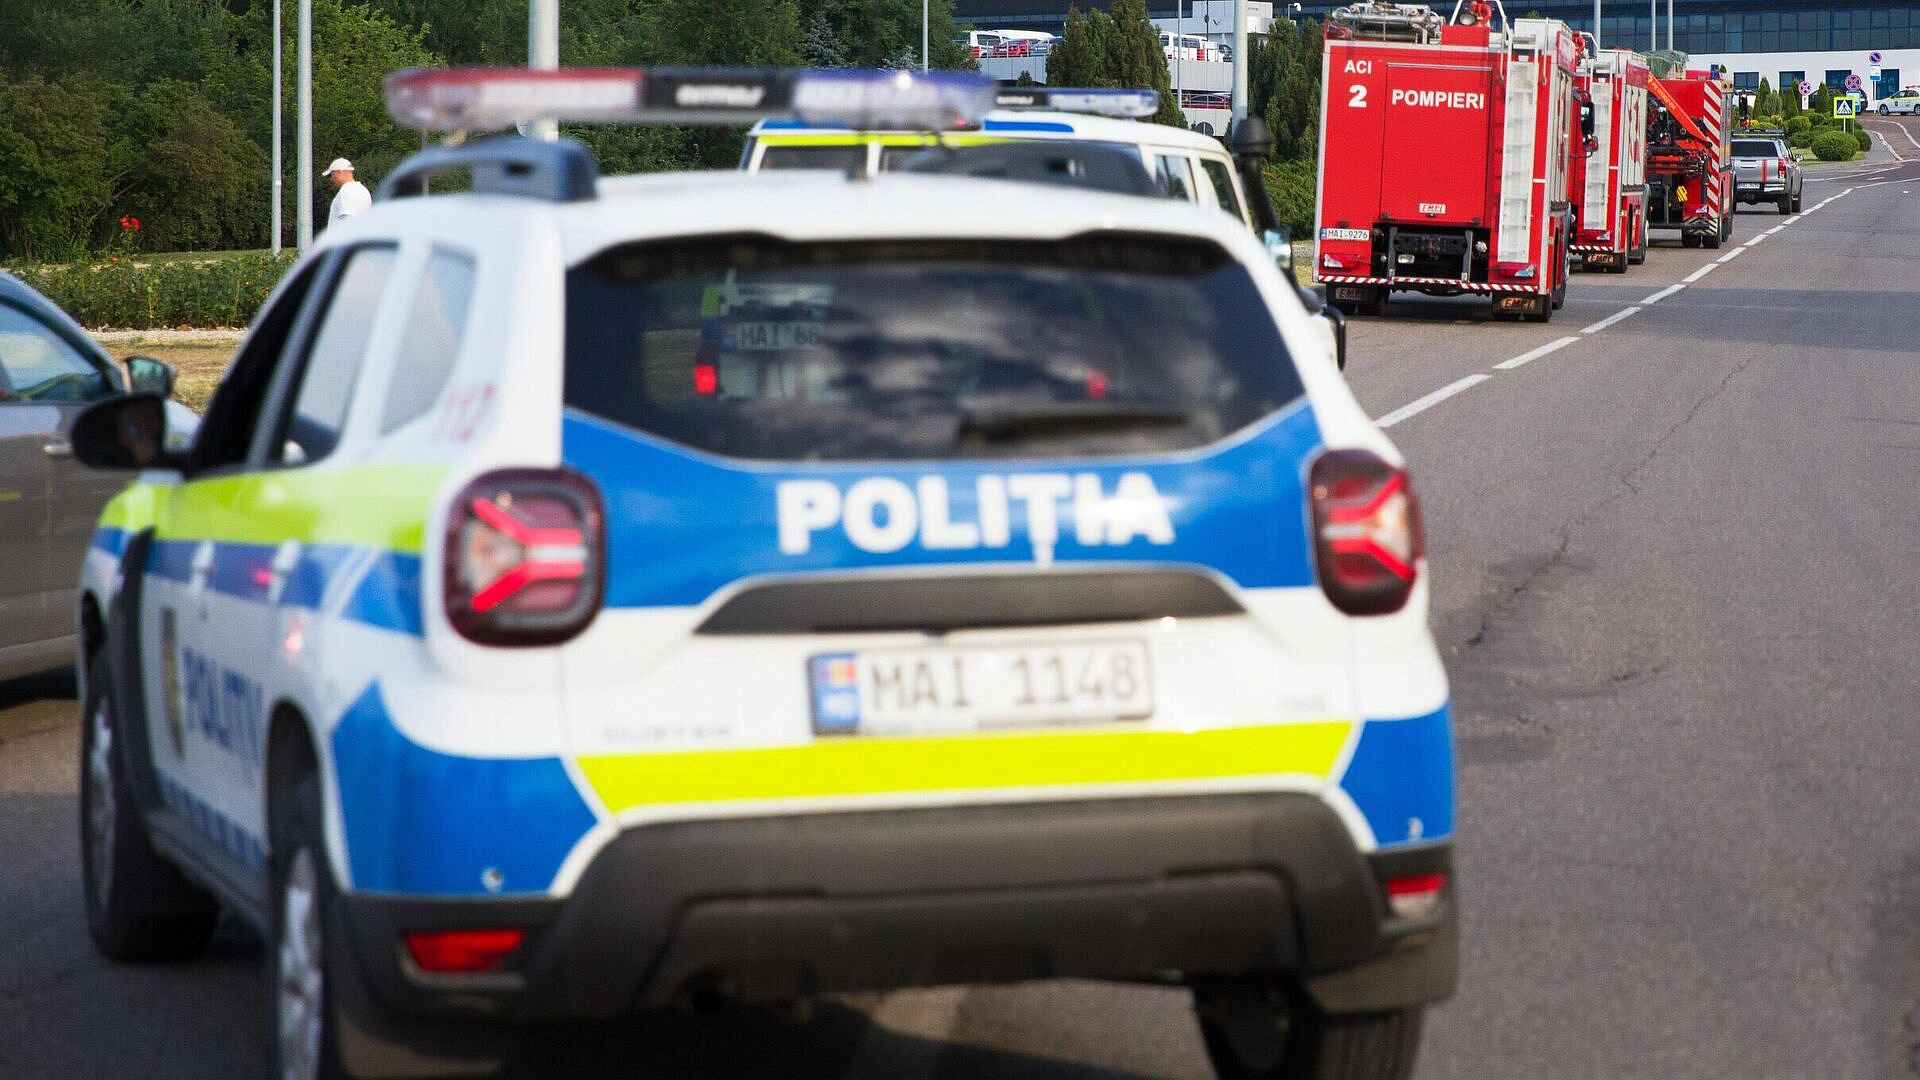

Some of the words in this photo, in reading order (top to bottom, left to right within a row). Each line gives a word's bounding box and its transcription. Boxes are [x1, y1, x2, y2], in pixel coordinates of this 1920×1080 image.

[1344, 60, 1372, 75] ACI
[1348, 84, 1368, 108] 2
[1392, 89, 1485, 110] POMPIERI
[1328, 229, 1343, 239] MAI
[1348, 230, 1368, 240] 9276
[872, 656, 969, 709] MAI
[1012, 652, 1138, 706] 1148
